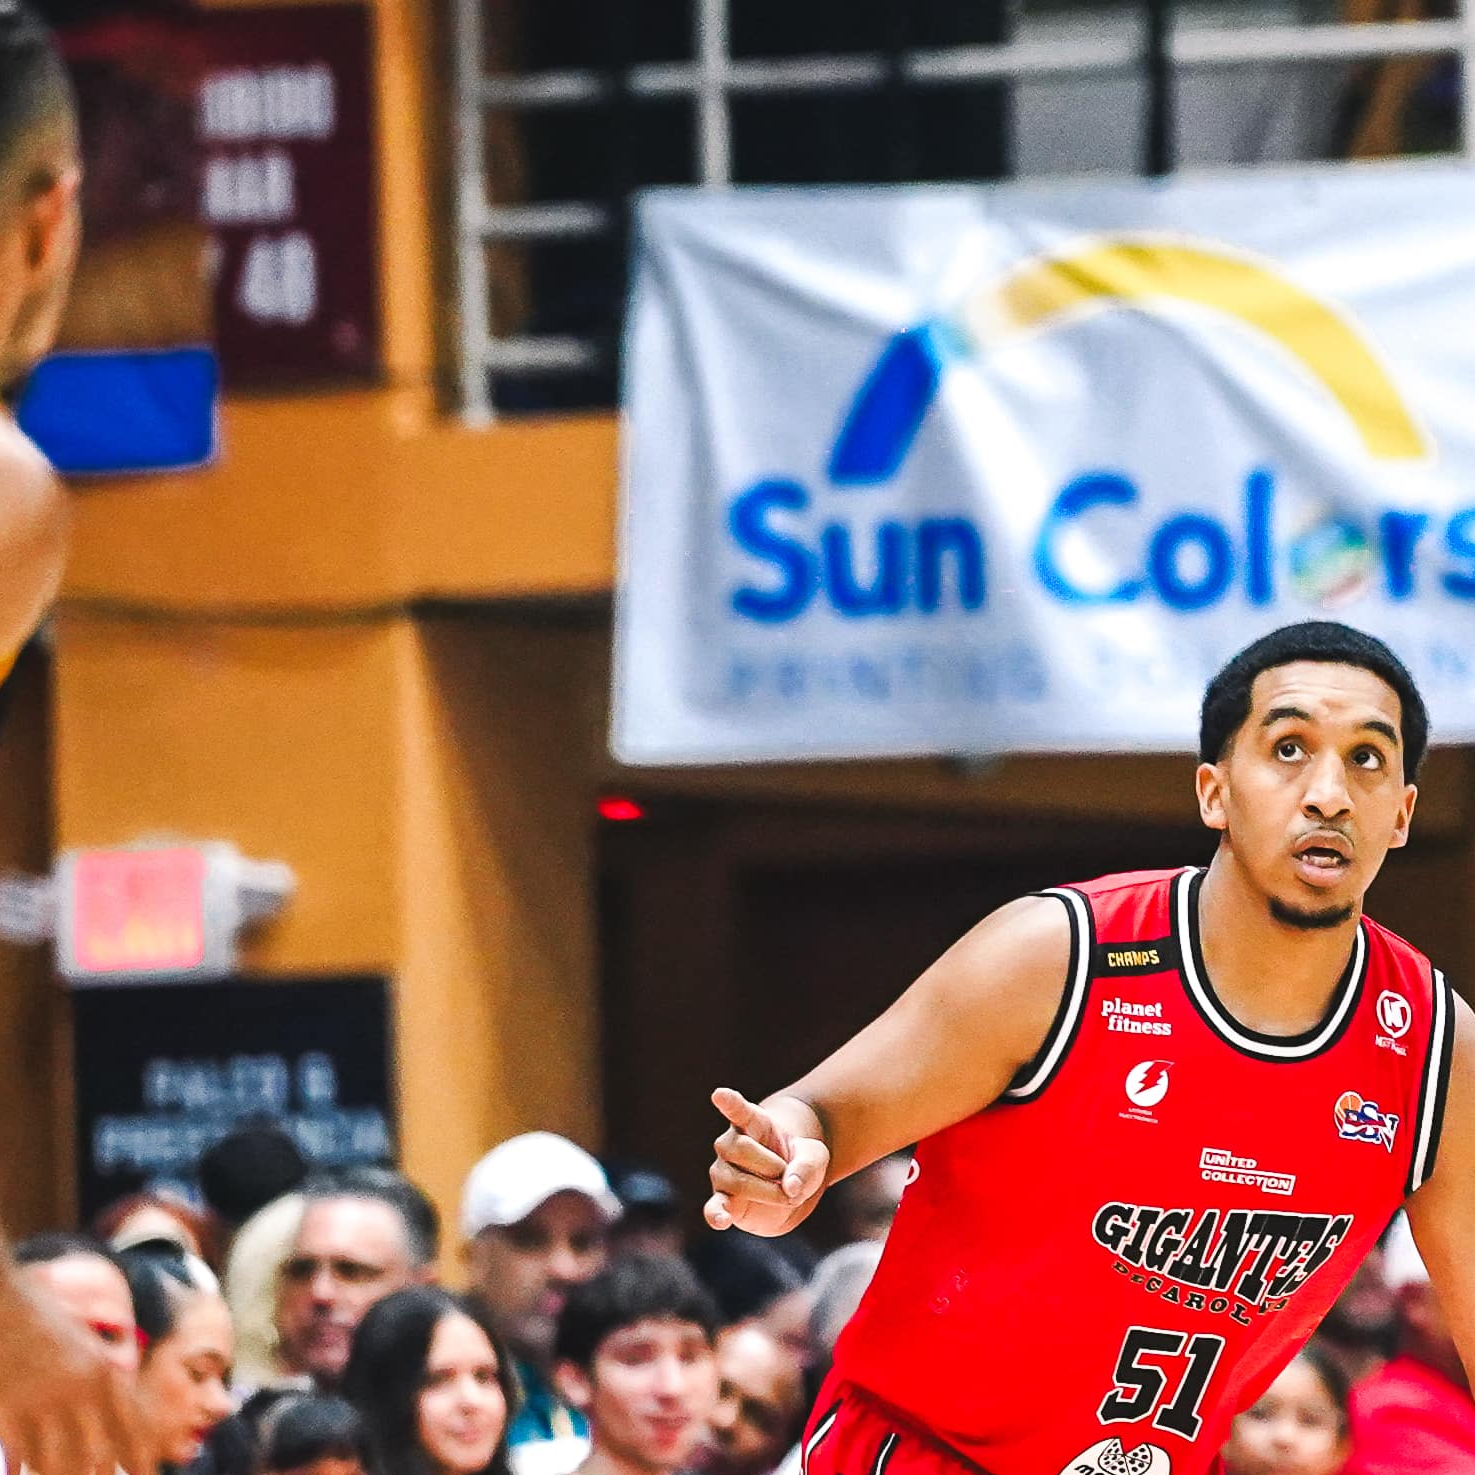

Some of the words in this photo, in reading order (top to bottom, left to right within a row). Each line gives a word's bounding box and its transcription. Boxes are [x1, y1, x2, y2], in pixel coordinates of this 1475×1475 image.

[727, 476, 987, 622] Sun
[1107, 949, 1160, 968] CHAMPS
[1101, 997, 1163, 1017] planet
[1107, 1014, 1172, 1036] fitness
[1204, 1152, 1258, 1170] UNITED
[1200, 1169, 1291, 1191] COLLECTION
[1091, 1200, 1355, 1306] GIGANTES
[1095, 1325, 1227, 1443] 51
